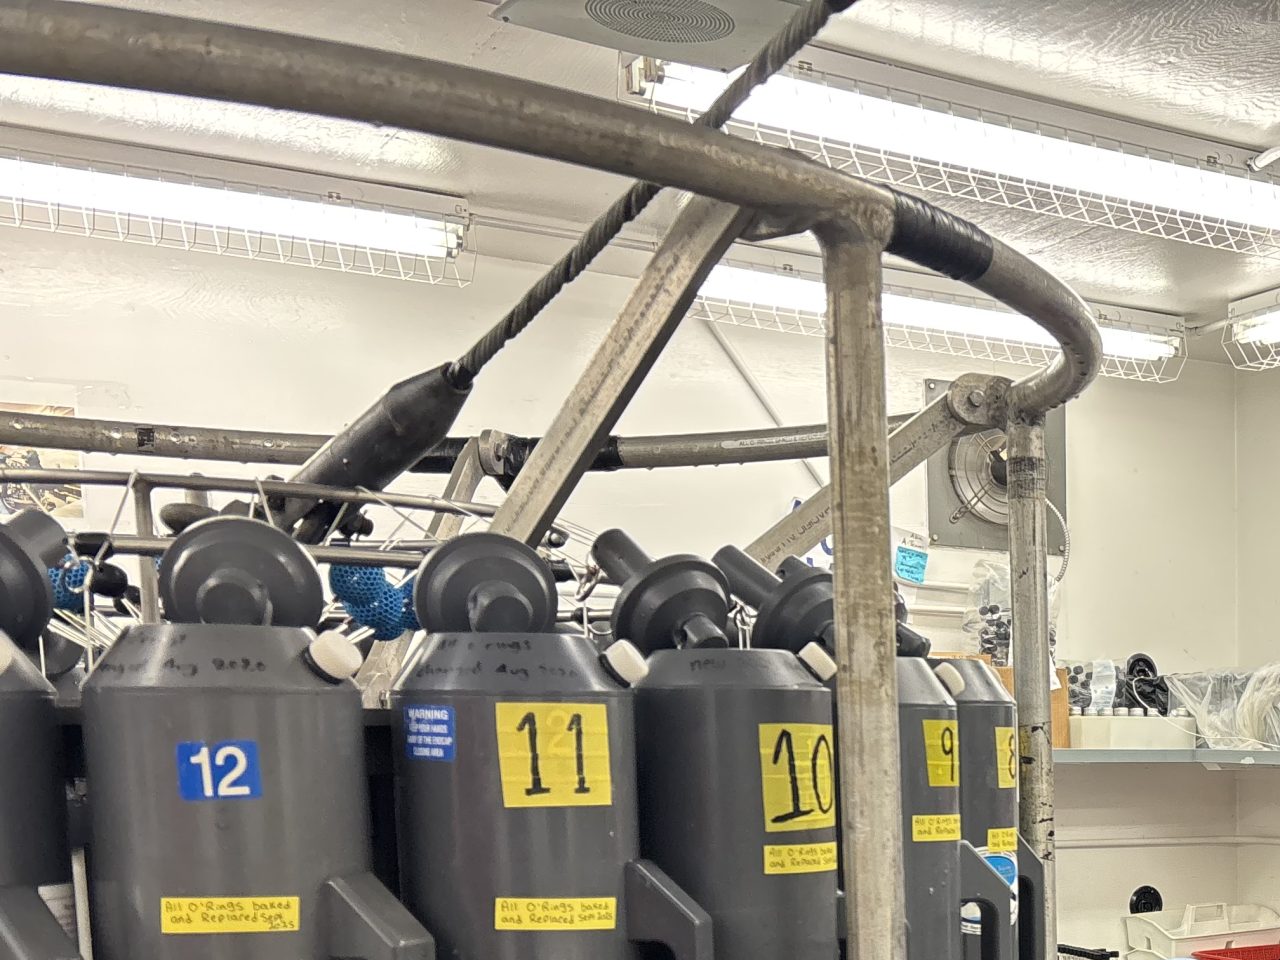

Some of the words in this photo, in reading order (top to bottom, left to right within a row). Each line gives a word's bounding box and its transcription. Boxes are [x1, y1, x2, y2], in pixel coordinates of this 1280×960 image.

[408, 708, 449, 720] WARNING
[517, 711, 591, 796] 11
[941, 727, 954, 782] 9
[189, 746, 250, 797] 12
[771, 728, 832, 823] 10
[165, 901, 183, 912] All
[252, 900, 291, 911] baked
[501, 901, 518, 912] All
[170, 913, 192, 924] and
[501, 914, 522, 924] and
